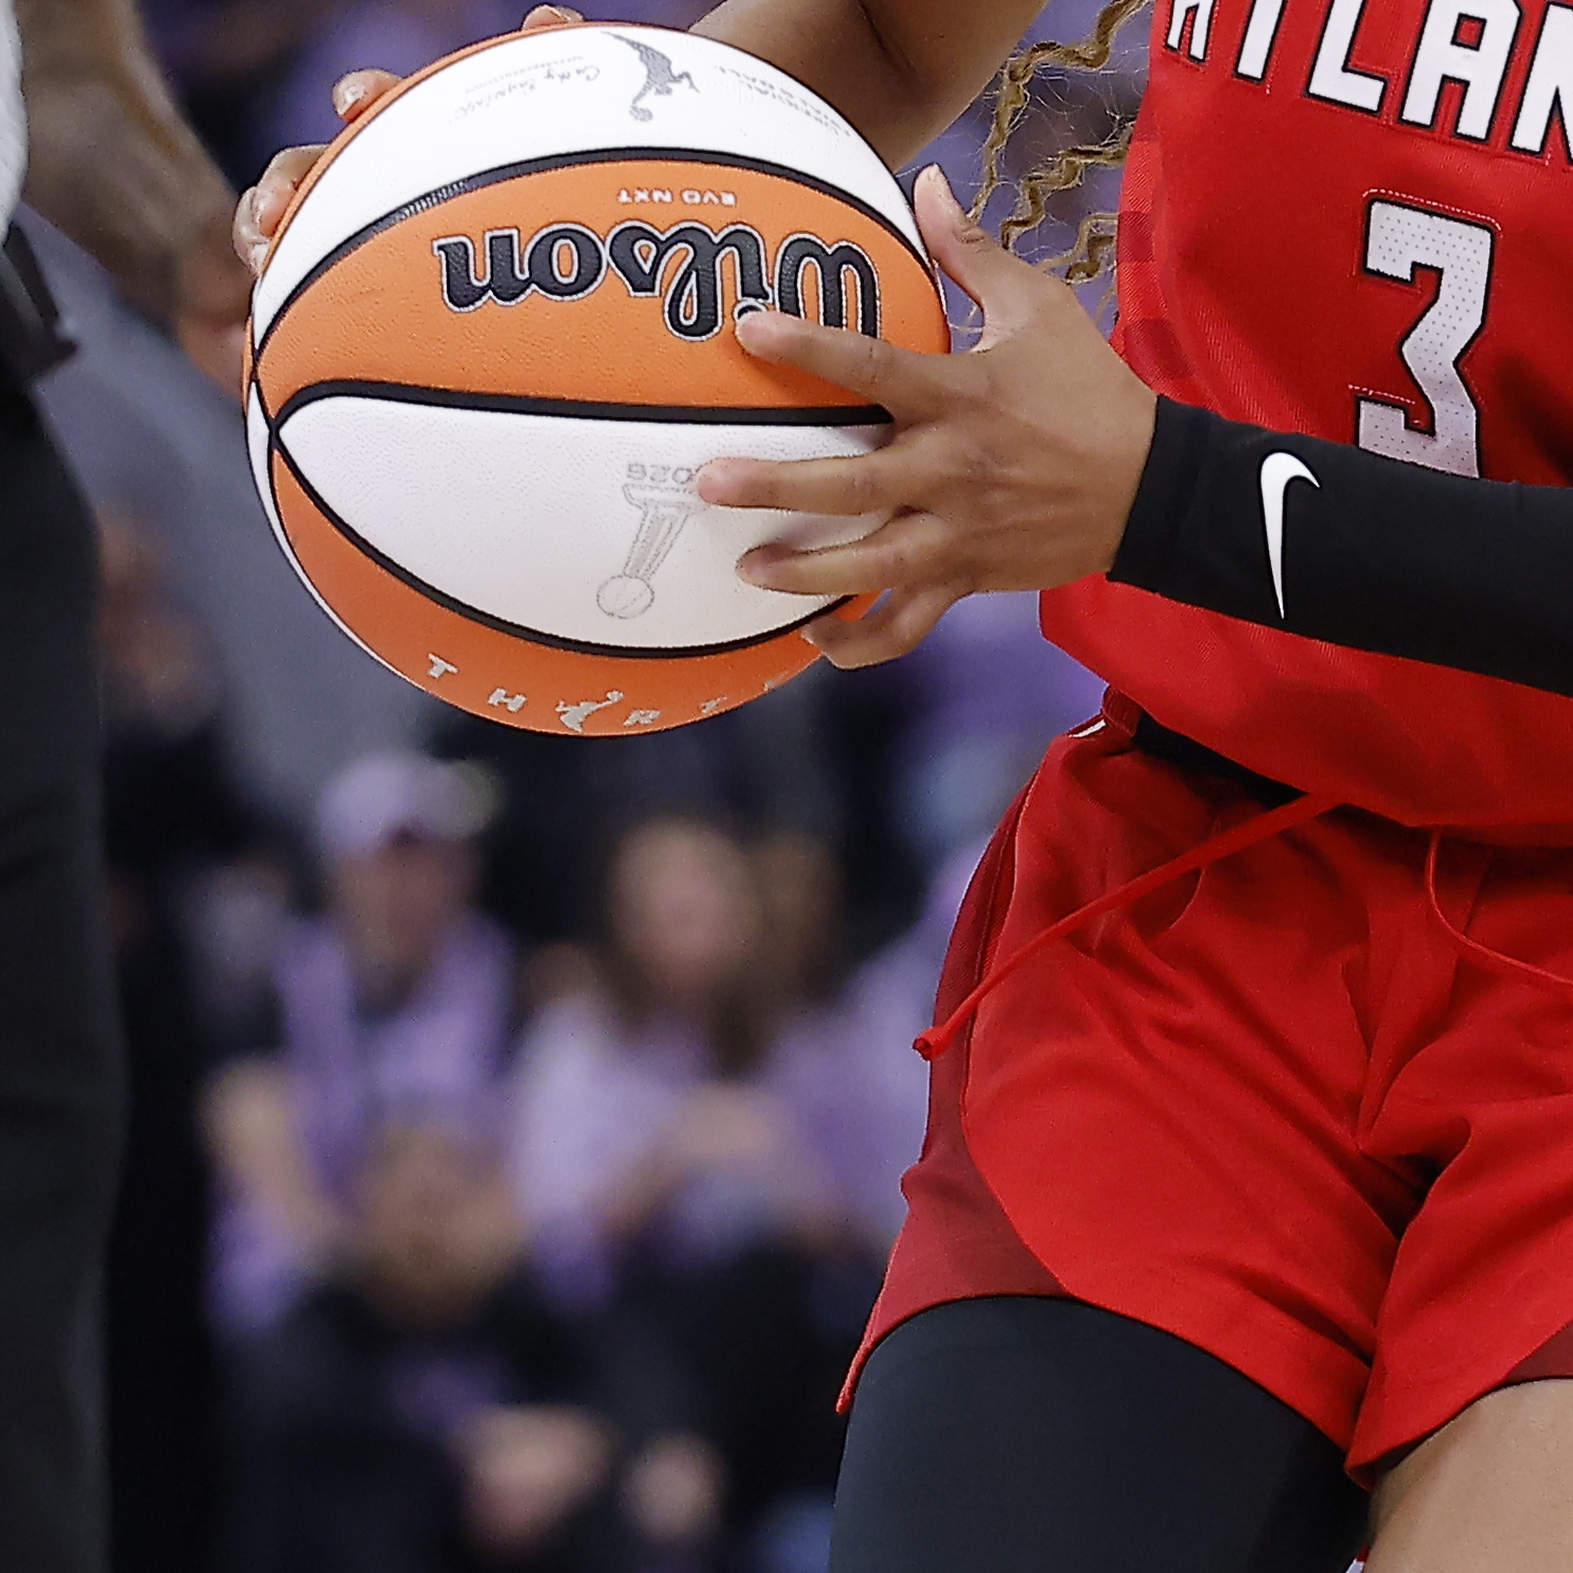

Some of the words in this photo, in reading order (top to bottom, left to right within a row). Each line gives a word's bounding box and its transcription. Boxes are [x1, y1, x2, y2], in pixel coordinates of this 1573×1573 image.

[431, 219, 881, 343] Wilson
[1358, 196, 1493, 478] 3
[626, 463, 696, 485] 026
